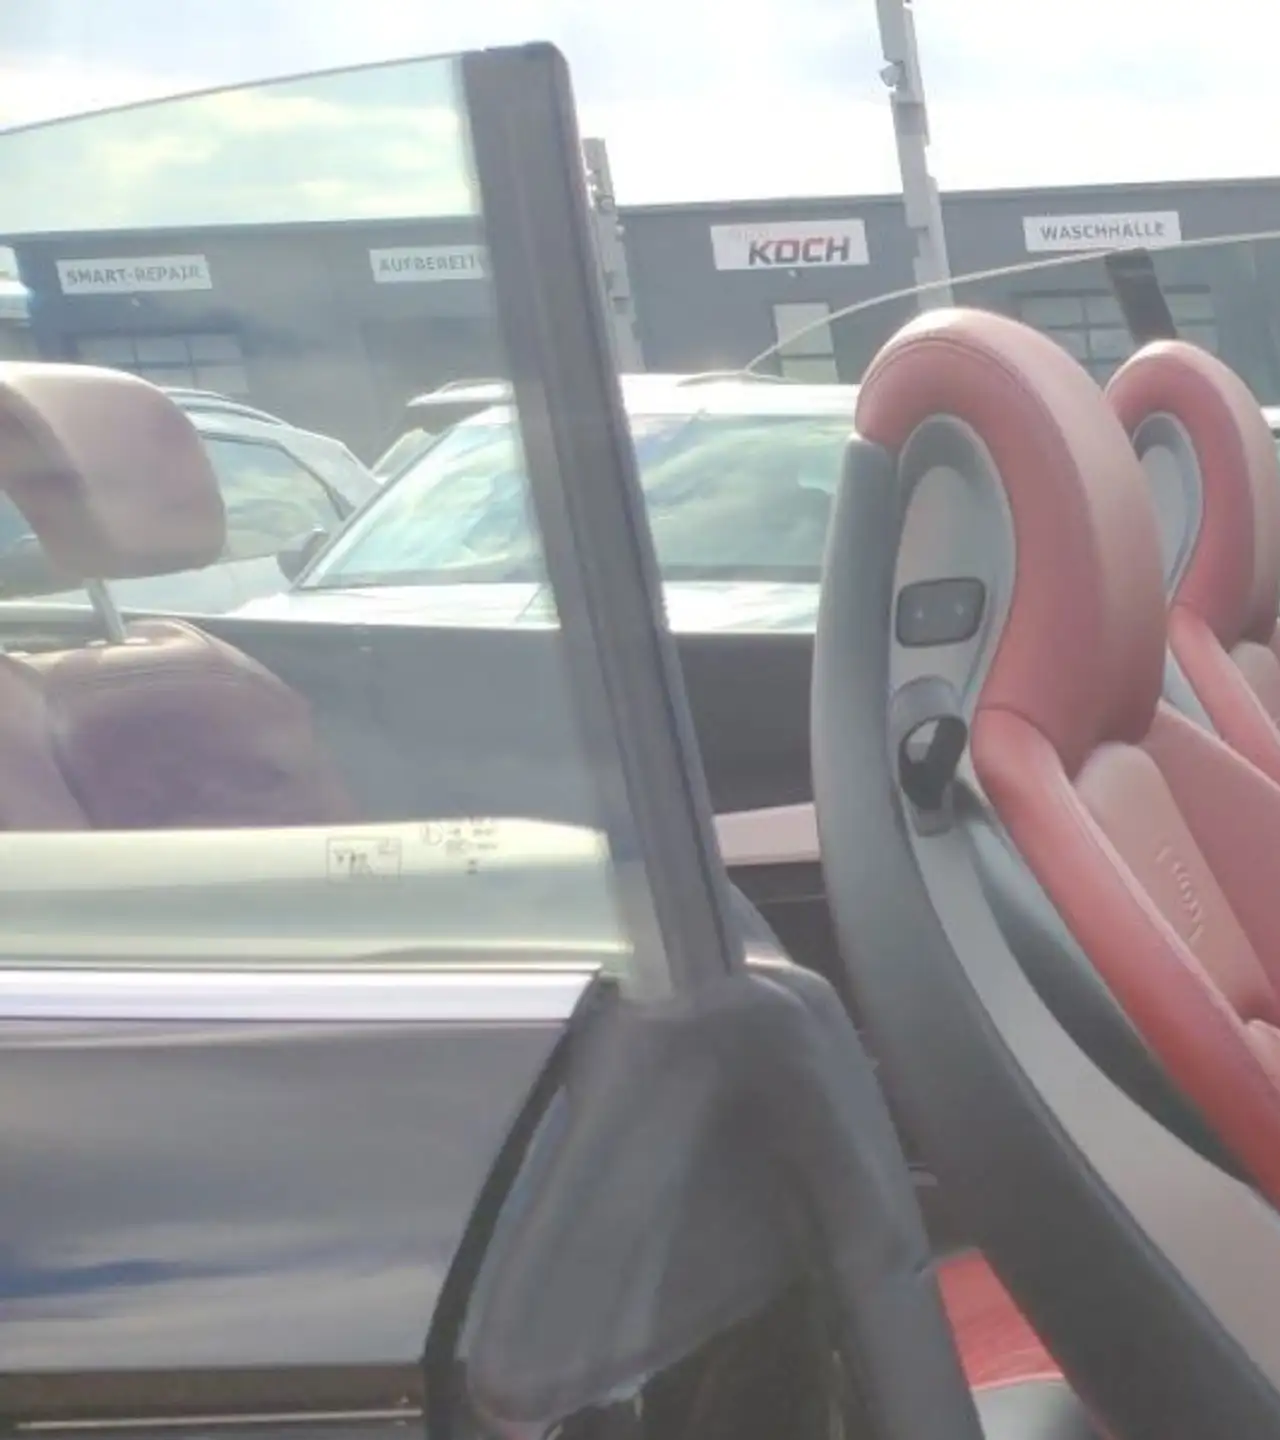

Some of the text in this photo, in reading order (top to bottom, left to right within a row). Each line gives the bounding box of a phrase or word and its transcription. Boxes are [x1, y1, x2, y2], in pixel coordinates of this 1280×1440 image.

[1040, 219, 1165, 242] WASCHHALLE
[748, 236, 851, 266] KOCH
[379, 253, 476, 272] AUFBEREIT
[66, 264, 204, 286] SMART-REPAIR
